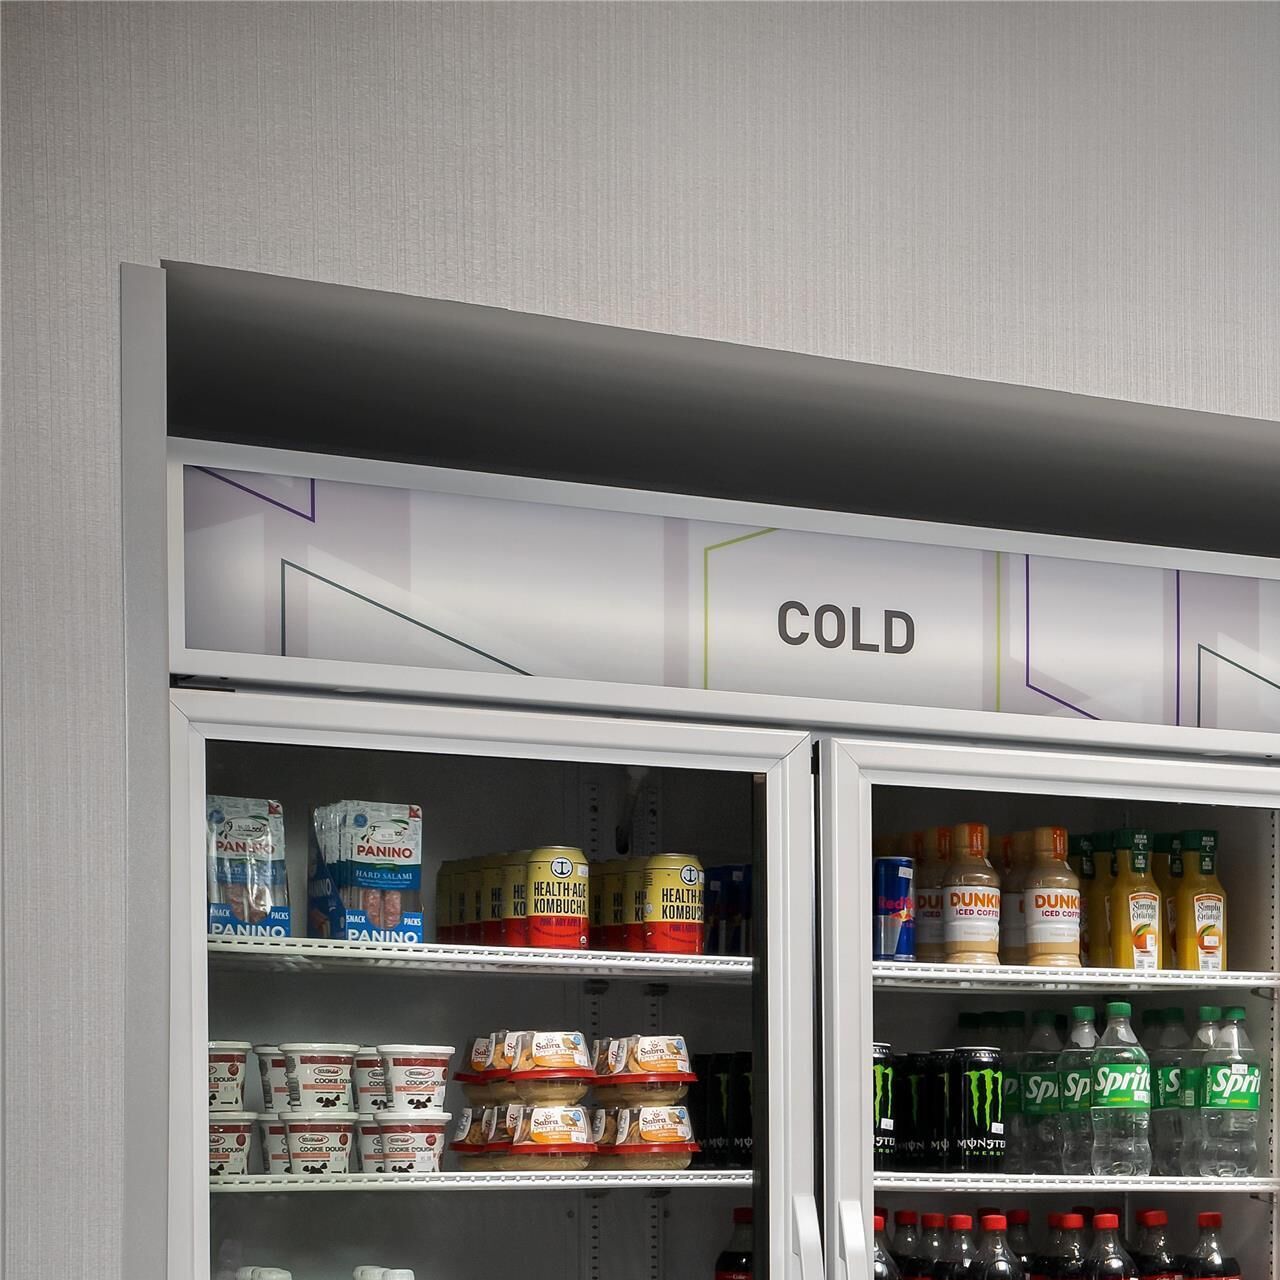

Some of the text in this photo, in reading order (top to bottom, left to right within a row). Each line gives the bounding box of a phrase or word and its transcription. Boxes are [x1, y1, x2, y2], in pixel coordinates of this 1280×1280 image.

[776, 600, 916, 655] COLD
[356, 844, 413, 859] PANINO
[355, 869, 413, 880] HARD SALAMI
[533, 898, 586, 914] KOMBUCHA
[403, 918, 422, 927] PACKS
[535, 1040, 561, 1052] Sabra
